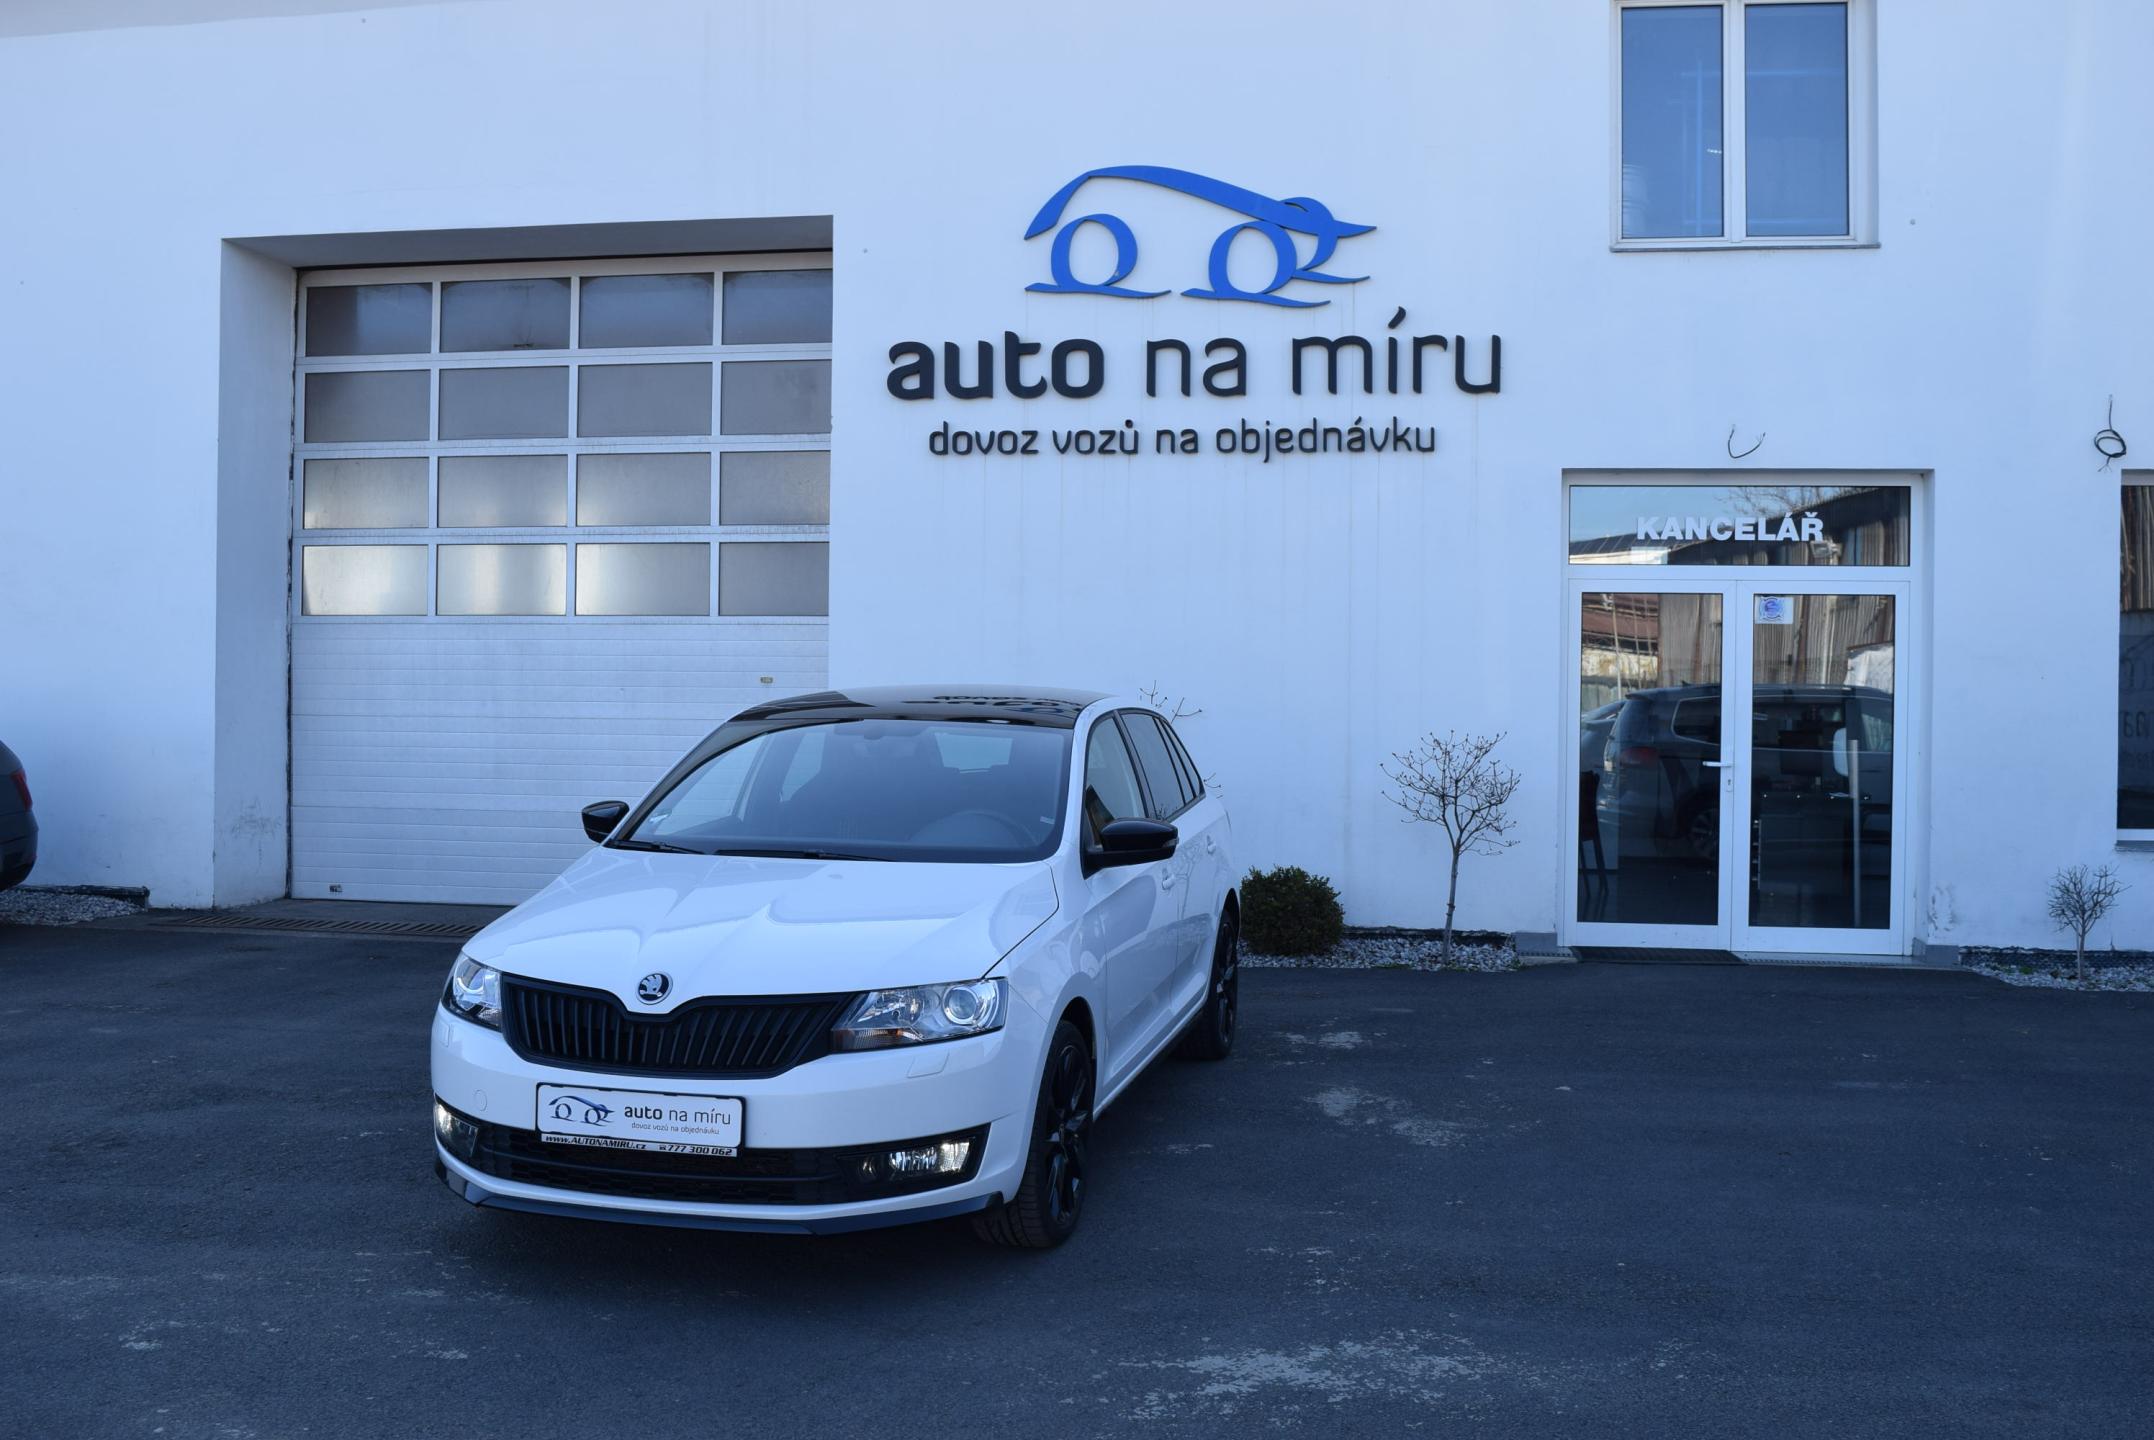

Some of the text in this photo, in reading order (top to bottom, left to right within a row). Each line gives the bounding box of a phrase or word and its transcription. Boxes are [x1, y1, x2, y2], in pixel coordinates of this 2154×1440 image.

[886, 306, 1502, 402] auto na míru
[929, 416, 1436, 464] dovoz vozů na objednávku
[1636, 511, 1824, 542] KANCELÁŘ
[624, 1105, 731, 1125] auto na míru
[631, 1121, 651, 1130] dovoz
[652, 1123, 669, 1132] vozů
[680, 1126, 720, 1135] objednávku
[667, 1144, 733, 1156] 777 300 062
